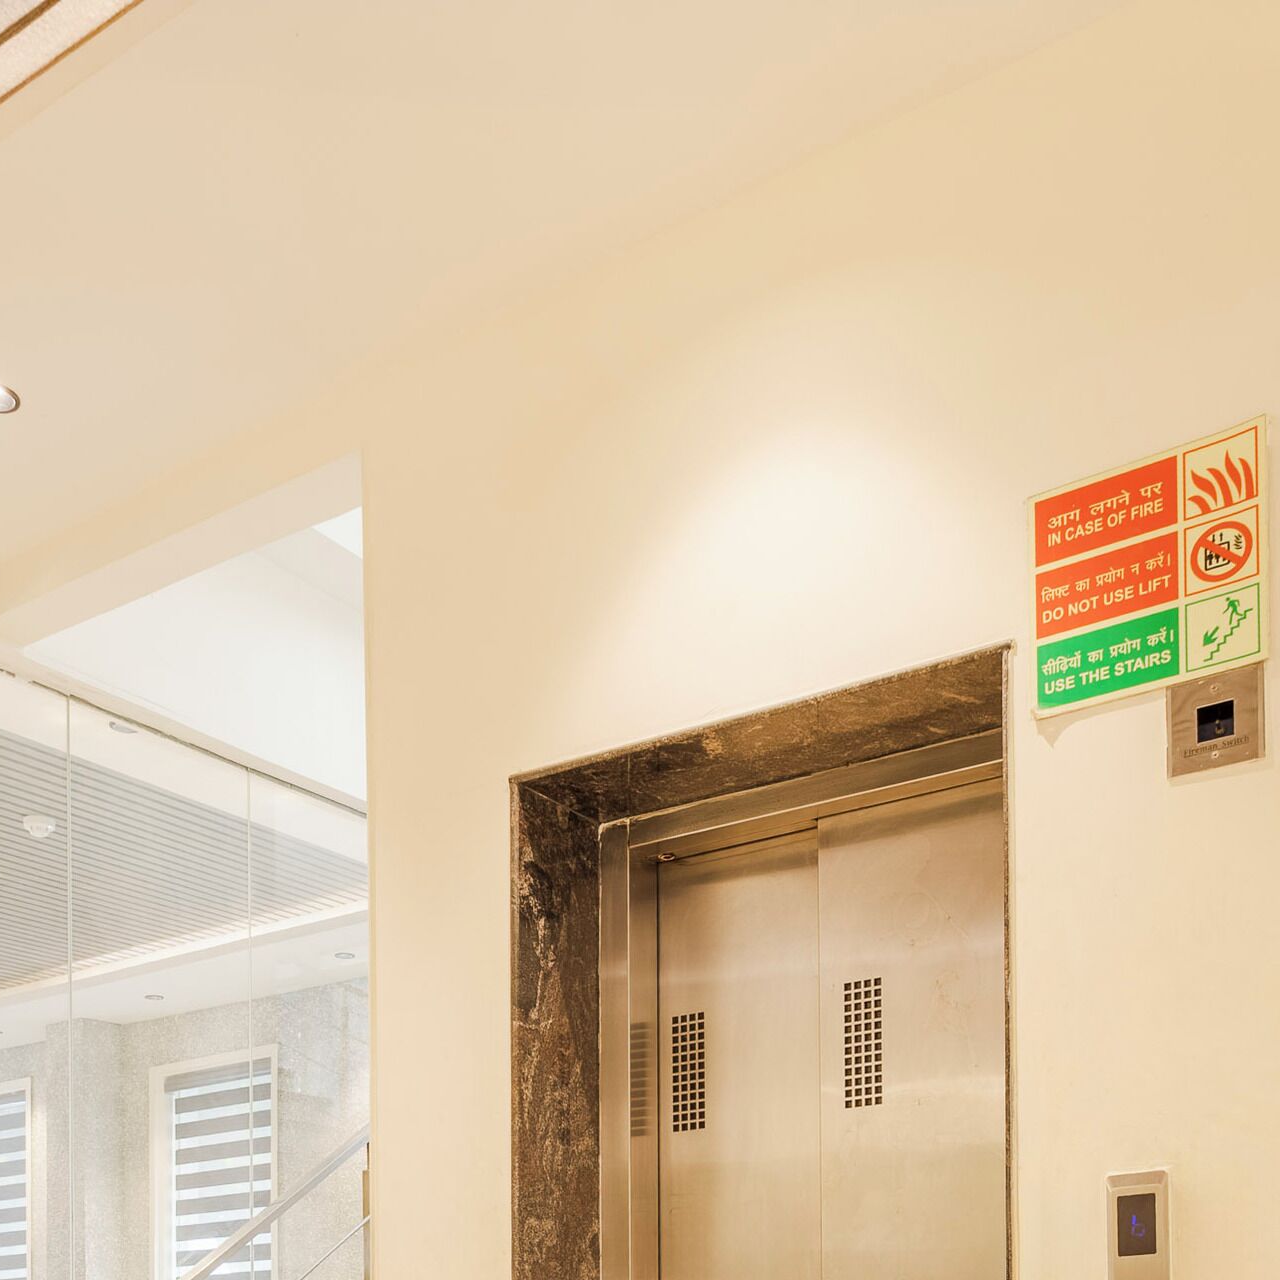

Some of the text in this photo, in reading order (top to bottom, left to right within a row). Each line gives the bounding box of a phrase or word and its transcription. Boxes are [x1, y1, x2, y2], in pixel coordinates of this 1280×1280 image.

[1047, 498, 1164, 548] IN CASE OF FIRE
[1048, 481, 1164, 529] आग लगने पर
[1042, 575, 1171, 624] DO NOT USE LIFT
[1075, 578, 1090, 593] का
[1095, 567, 1125, 587] प्रयोग
[1130, 563, 1140, 575] न
[1044, 650, 1172, 695] USE THE STAIRS
[1087, 648, 1104, 663] का
[1109, 637, 1141, 658] प्रयोग
